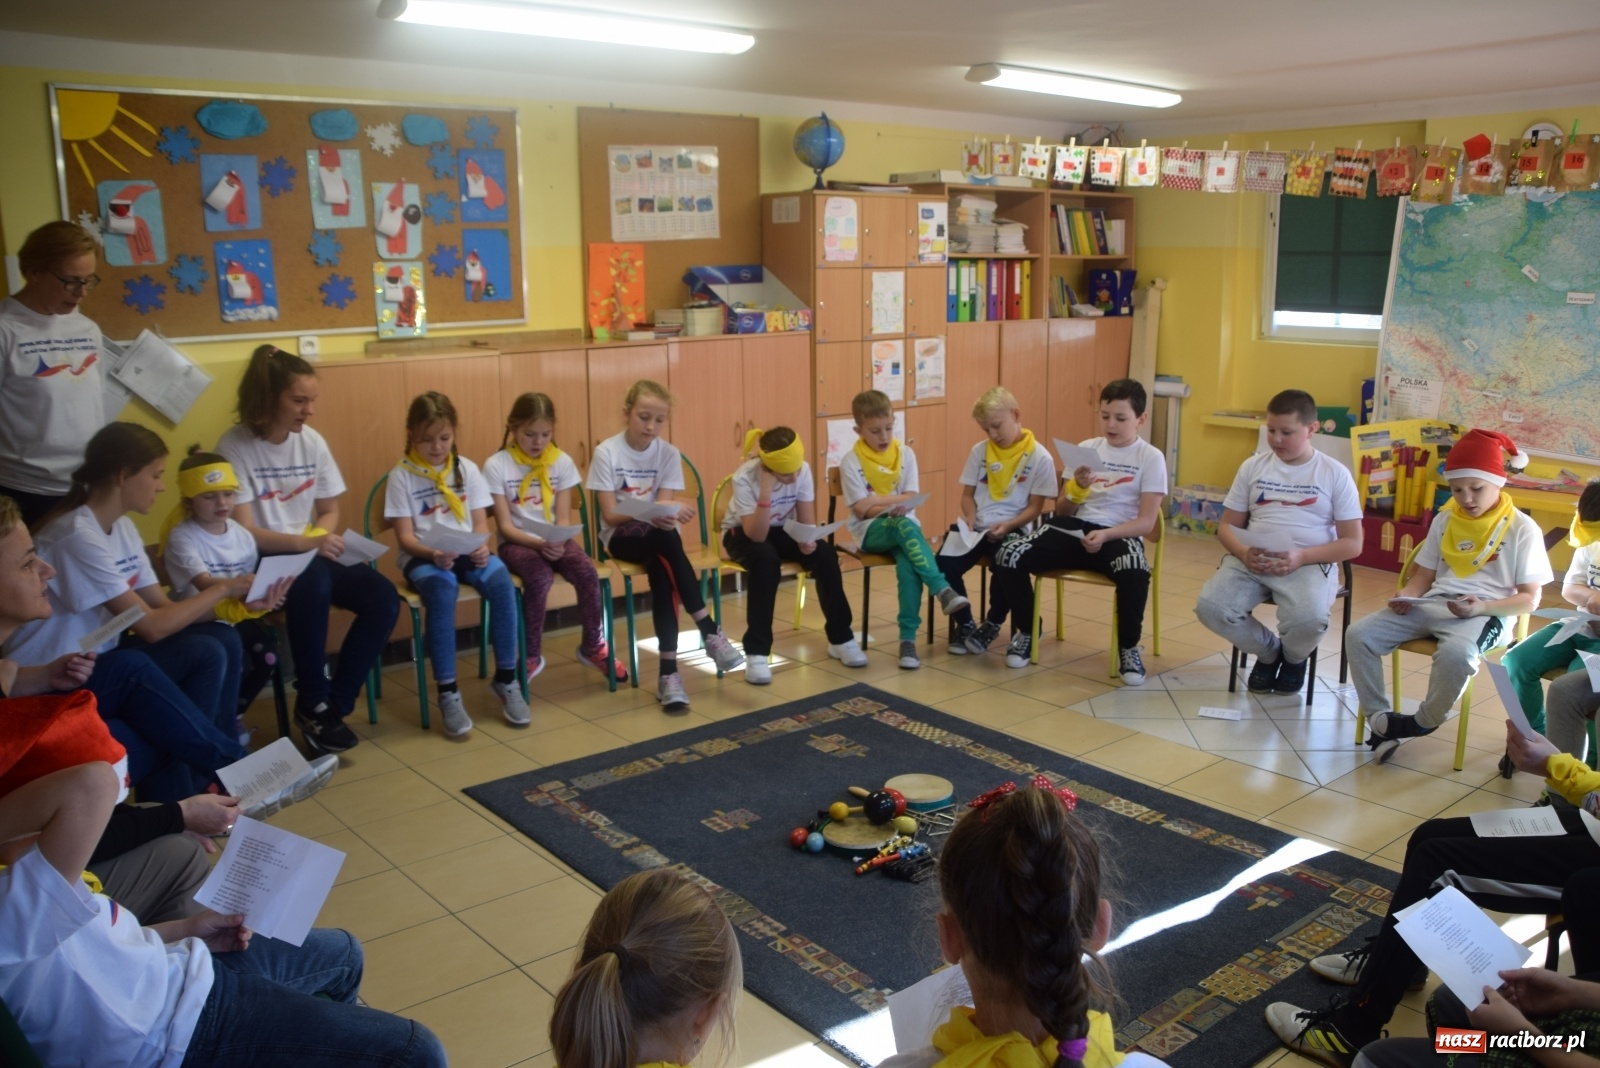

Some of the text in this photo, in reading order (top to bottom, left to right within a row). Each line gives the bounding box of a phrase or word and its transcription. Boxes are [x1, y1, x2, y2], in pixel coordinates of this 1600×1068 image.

[1522, 158, 1532, 167] 15
[1572, 155, 1583, 164] 16
[1389, 167, 1399, 175] 12
[1434, 168, 1444, 177] 13
[1480, 164, 1490, 173] 14
[1400, 377, 1428, 387] POLSKA
[905, 538, 930, 568] OUT
[1110, 553, 1150, 573] CONTR
